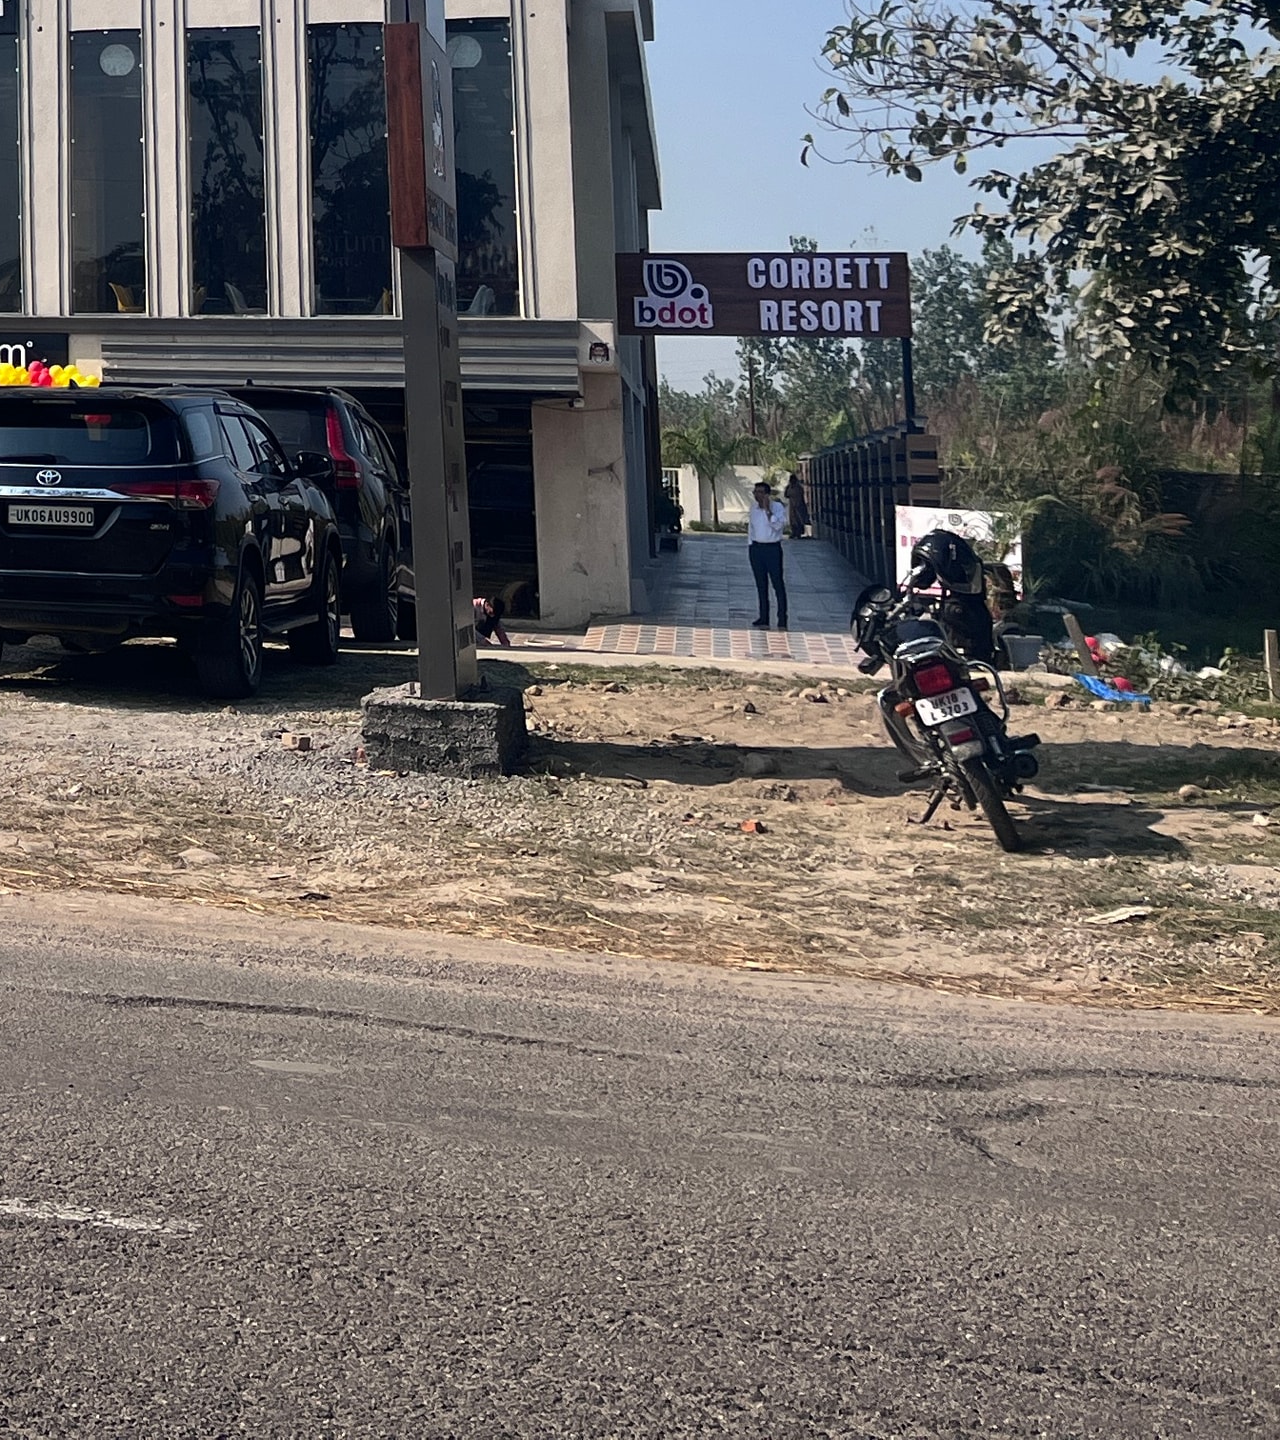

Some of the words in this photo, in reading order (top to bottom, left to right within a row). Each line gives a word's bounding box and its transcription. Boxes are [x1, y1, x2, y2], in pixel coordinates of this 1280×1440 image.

[747, 258, 890, 289] CORBETT
[638, 301, 709, 325] bdot
[760, 300, 882, 332] RESORT
[16, 508, 93, 524] UK06AU9900
